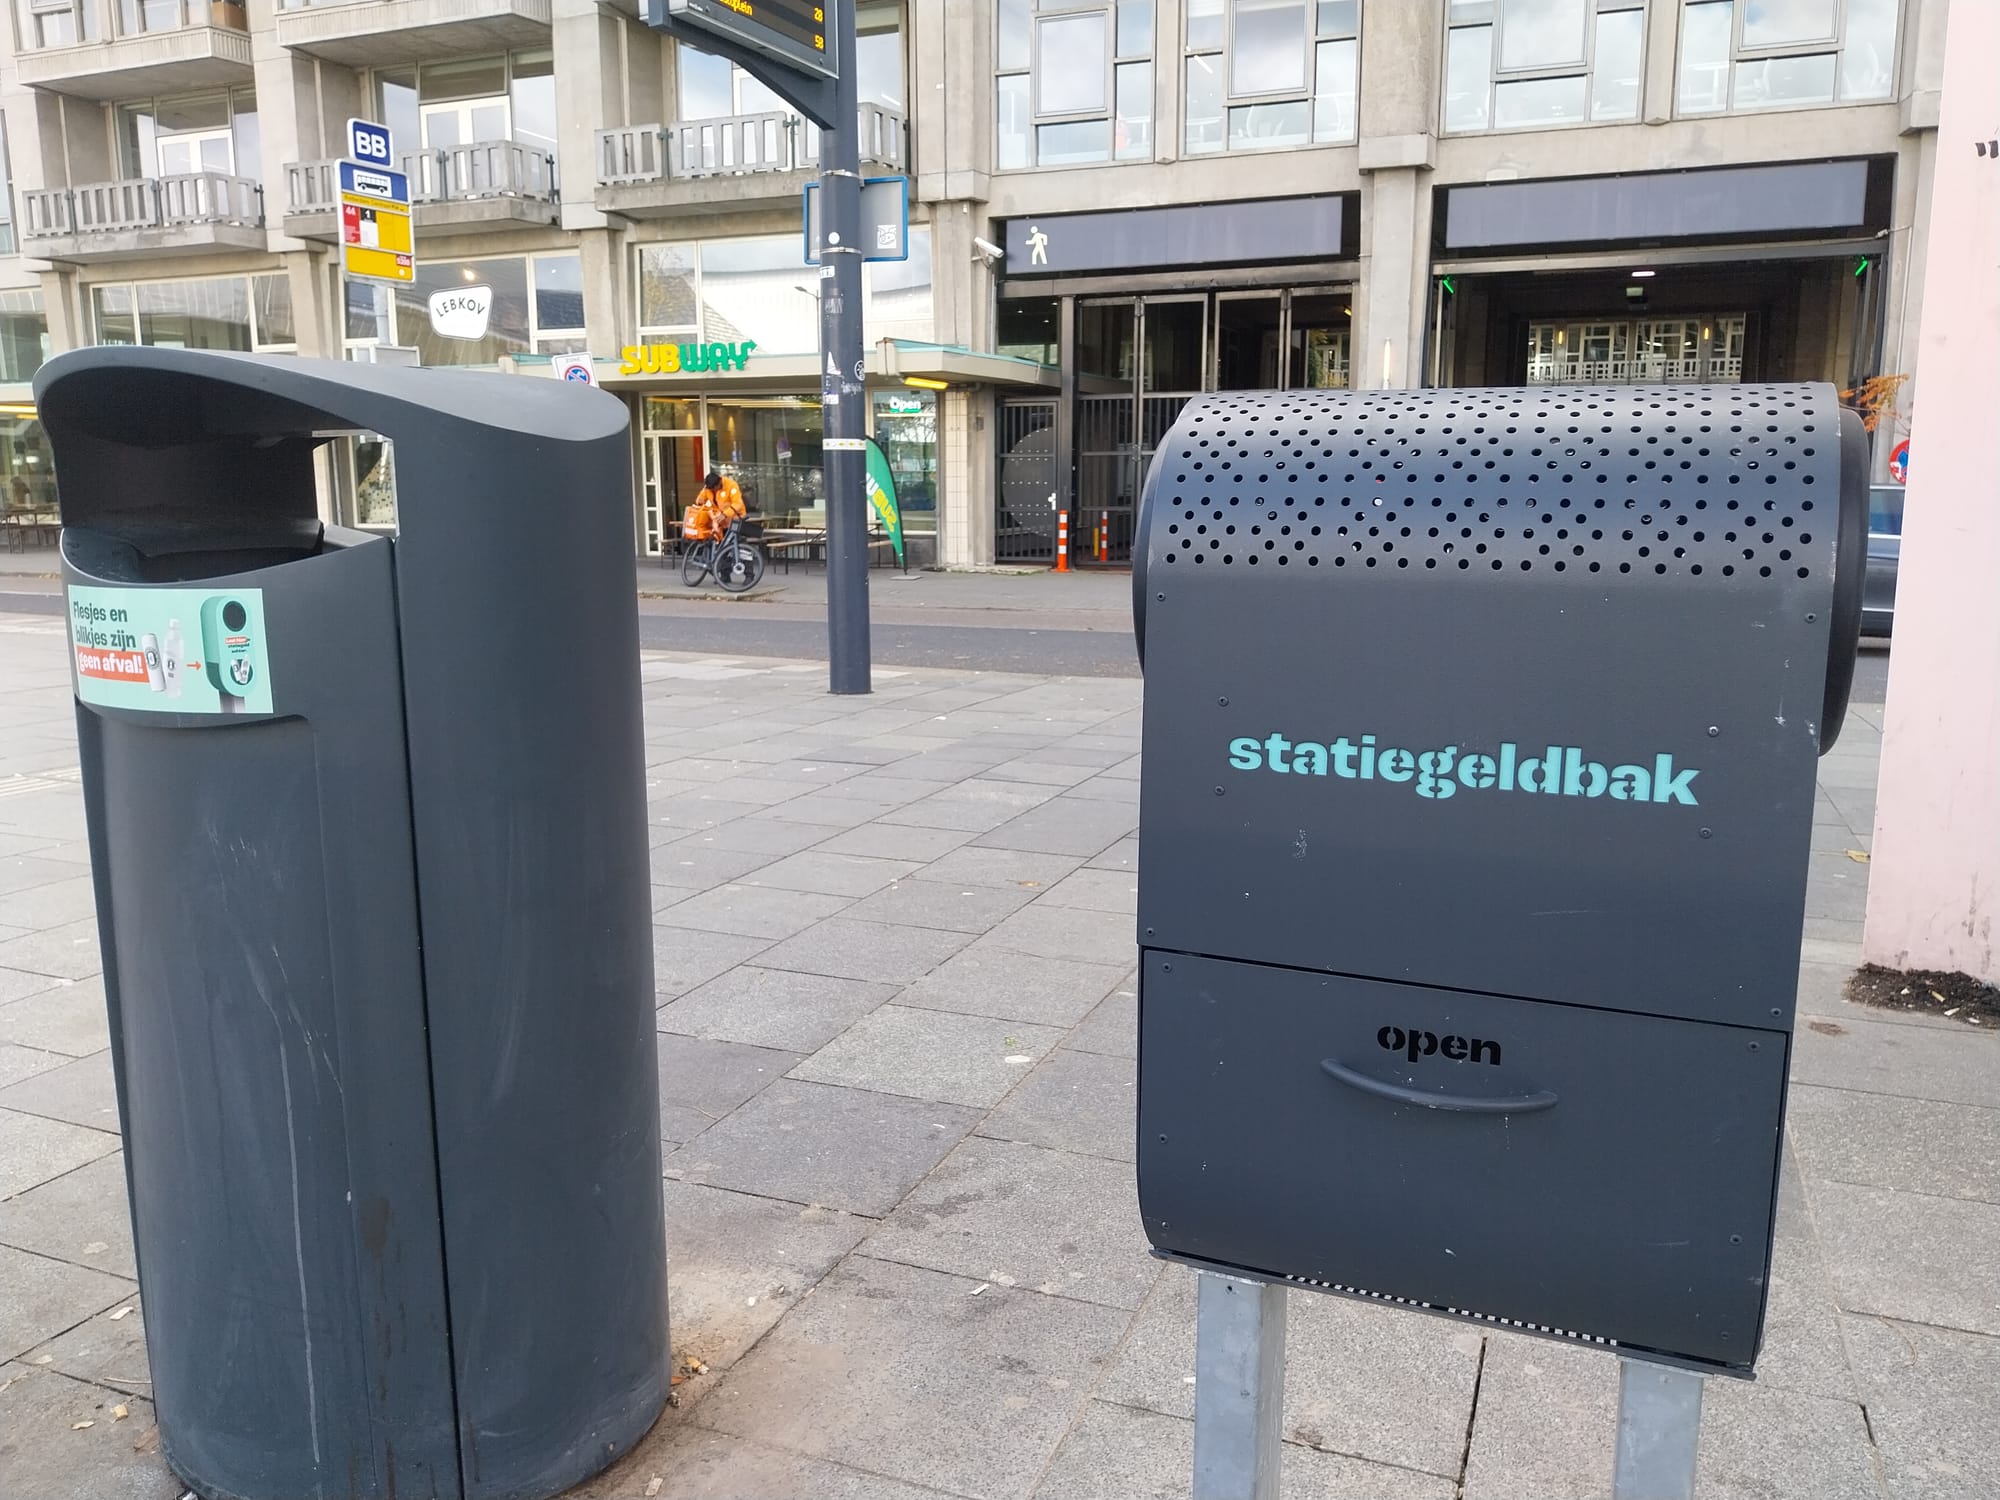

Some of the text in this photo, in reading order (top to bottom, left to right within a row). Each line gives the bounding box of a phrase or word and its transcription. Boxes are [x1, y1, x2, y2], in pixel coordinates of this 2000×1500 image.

[355, 130, 387, 158] BB
[345, 206, 357, 216] 44
[365, 209, 371, 219] 1
[435, 297, 486, 318] LEBKOV
[619, 339, 758, 377] SUBWAY
[889, 395, 922, 413] Open
[73, 600, 128, 625] Flesjes en
[76, 624, 136, 652] blikjes zijn
[79, 651, 144, 675] geen afval!
[1227, 731, 1701, 806] statiegeldbak
[1376, 1025, 1502, 1066] open
